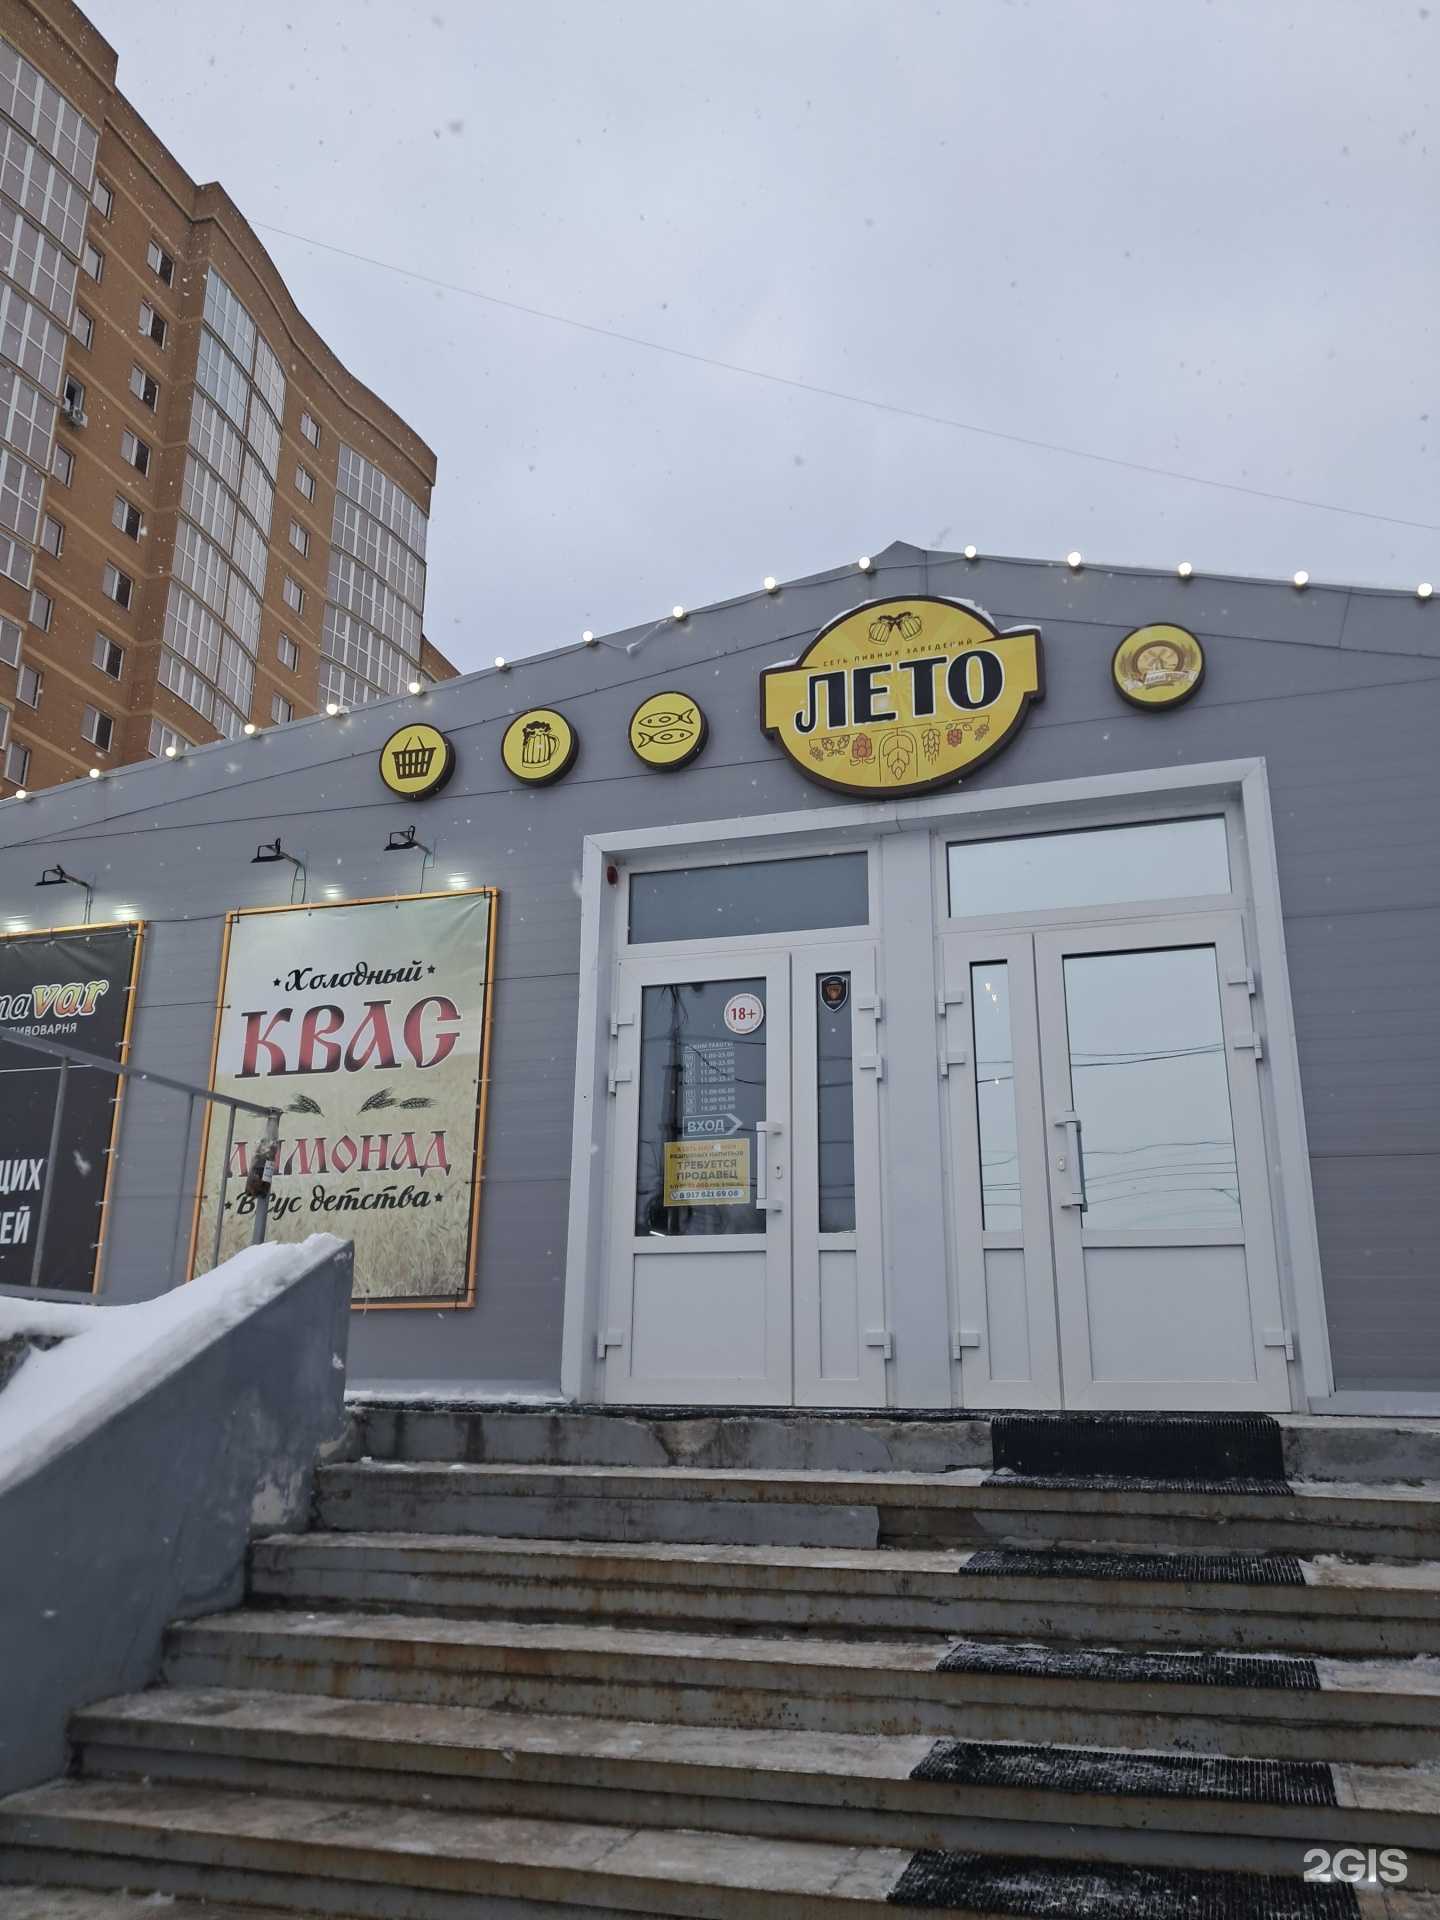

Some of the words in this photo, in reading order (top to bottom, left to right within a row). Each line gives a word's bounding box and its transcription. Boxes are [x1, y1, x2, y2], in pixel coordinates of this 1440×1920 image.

[823, 659, 848, 668] СЕТЬ
[854, 650, 900, 663] ПИВНЫХ
[793, 649, 1005, 735] ЛЕТО
[284, 961, 424, 992] Холодный
[730, 1007, 757, 1021] 18+
[234, 996, 462, 1079] КВАС
[687, 1119, 725, 1133] ВХОД
[676, 1158, 737, 1171] ТРЕБУЕТСЯ
[676, 1169, 738, 1181] ПРОДАВЕЦ
[309, 1184, 432, 1212] детства
